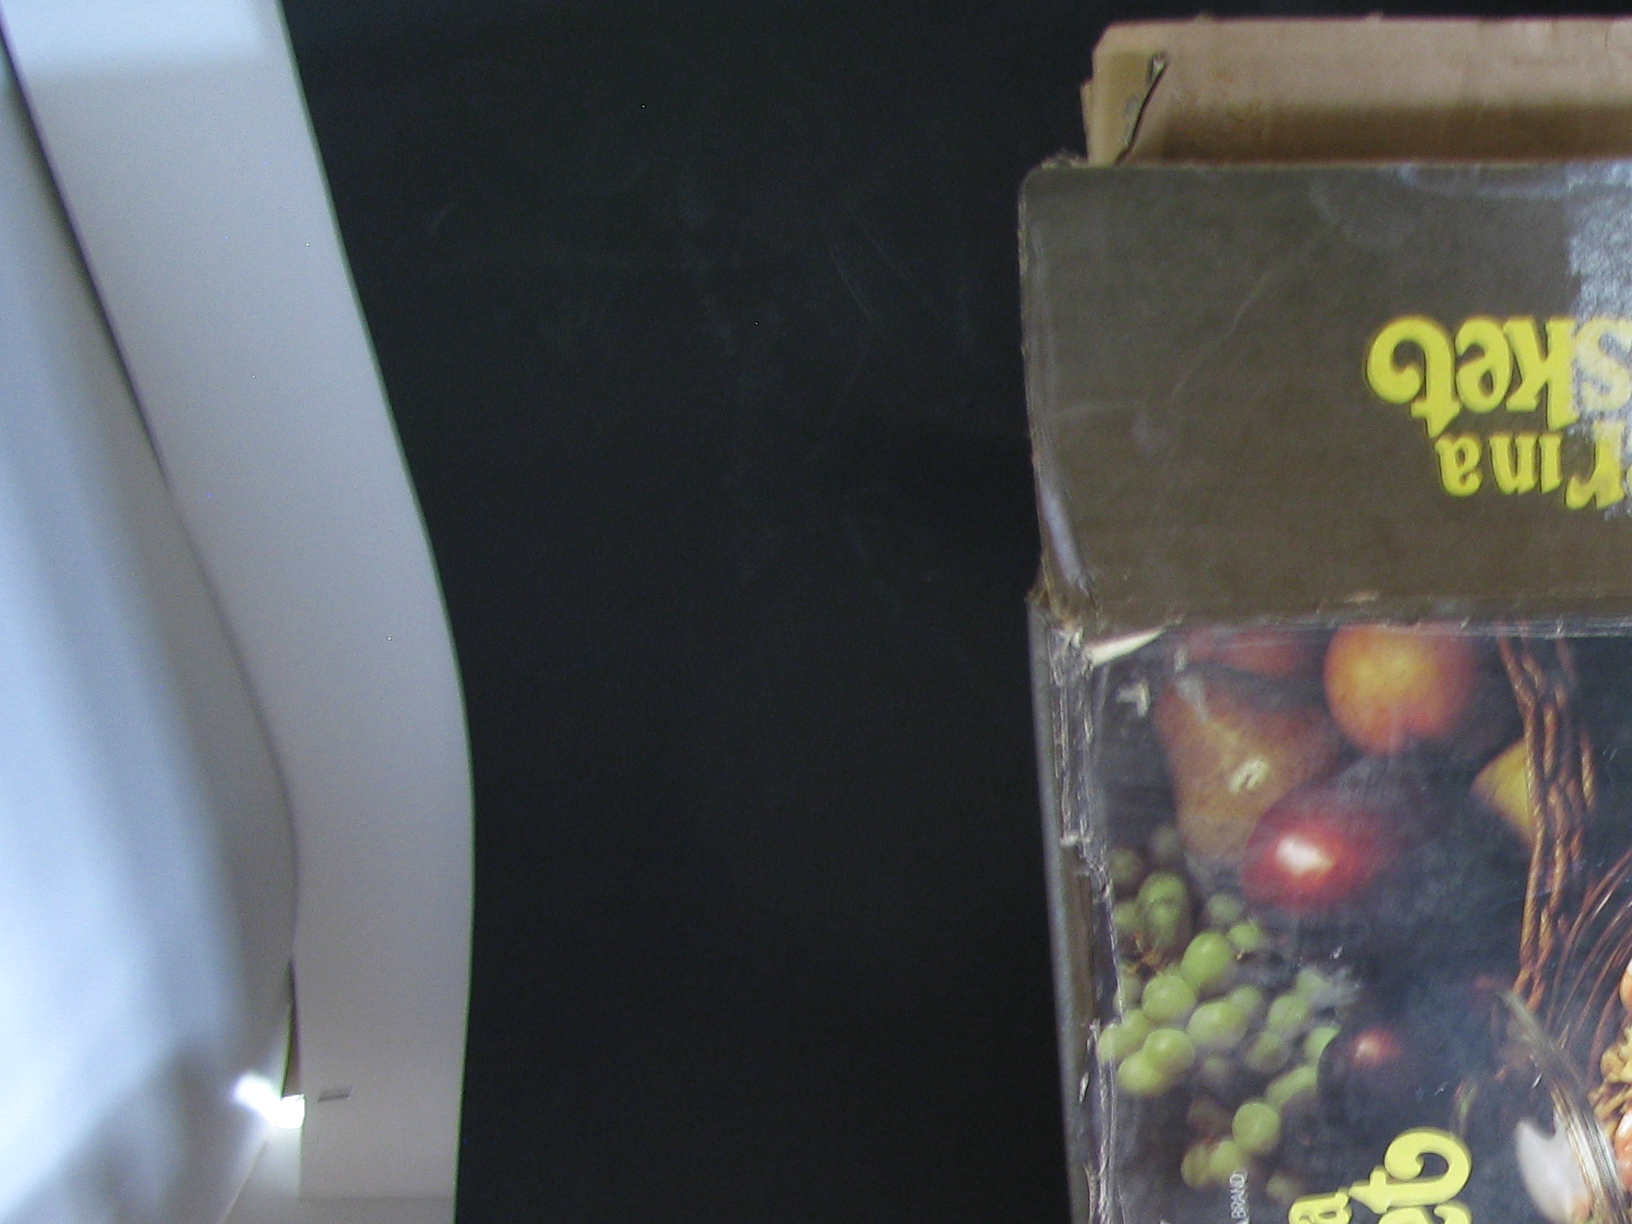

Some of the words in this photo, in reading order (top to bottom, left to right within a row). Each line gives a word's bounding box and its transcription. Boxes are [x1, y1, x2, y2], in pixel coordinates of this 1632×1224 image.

[1435, 432, 1482, 497] a
[1489, 433, 1561, 495] in
[1229, 1171, 1248, 1219] BRAND
